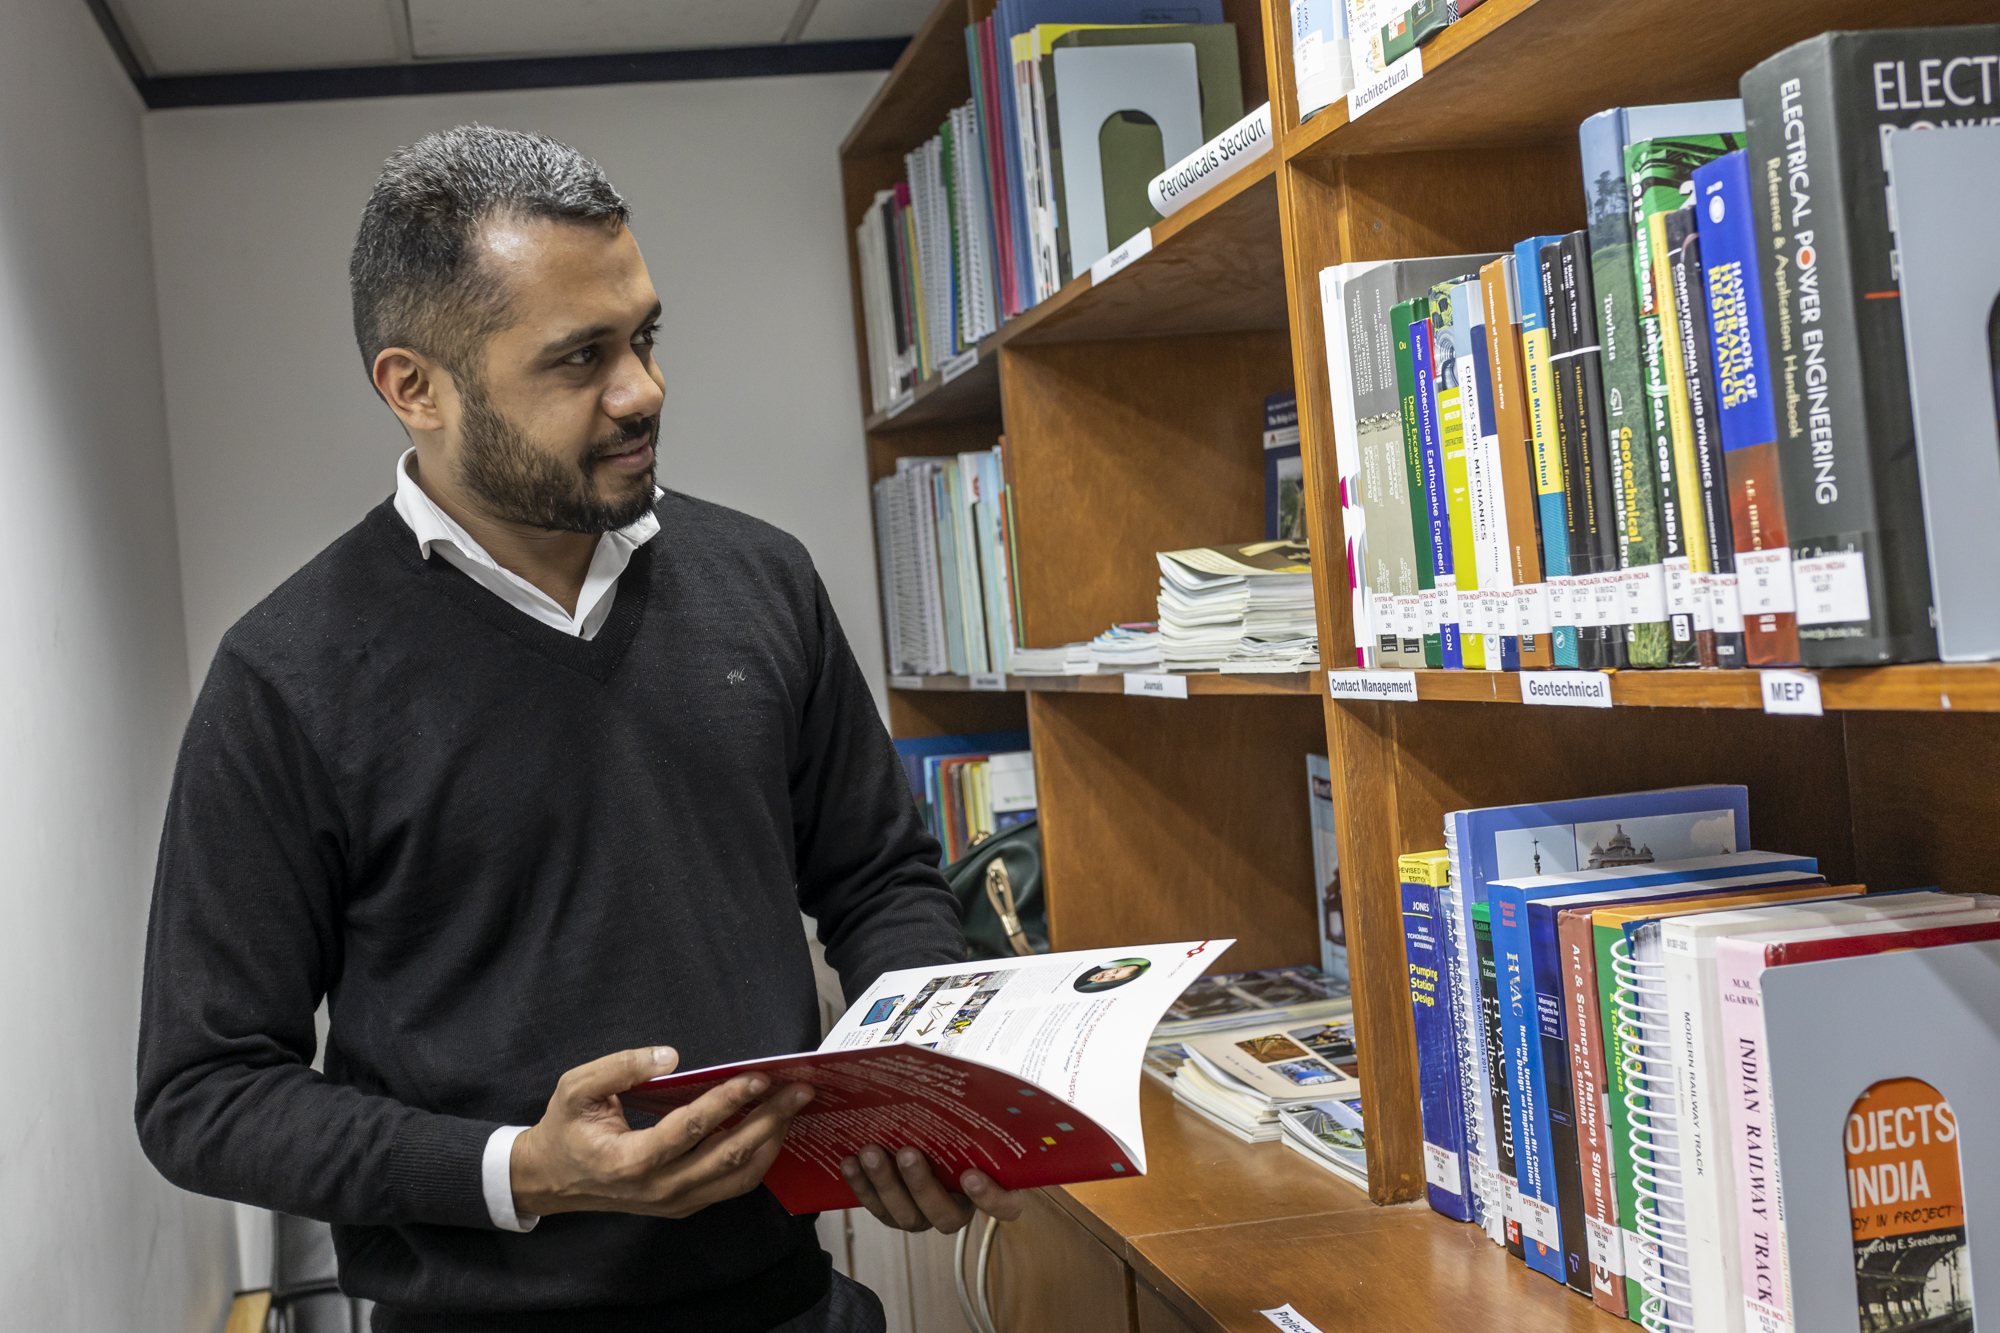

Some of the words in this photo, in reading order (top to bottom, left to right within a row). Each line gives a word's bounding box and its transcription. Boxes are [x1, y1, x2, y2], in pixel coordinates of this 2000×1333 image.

[1355, 63, 1409, 110] Architectural
[1873, 56, 2000, 110] ELECT
[1159, 147, 1219, 202] Periodicals
[1219, 118, 1266, 161] Section
[1780, 78, 1812, 227] ELECTRICAL
[1630, 171, 1644, 223] 2012
[1768, 156, 1783, 233] Reference
[1636, 227, 1653, 313] UNIFORM
[1795, 229, 1823, 324] POWER
[1488, 282, 1496, 325] Handbook
[1604, 293, 1616, 361] Towhata
[1676, 262, 1698, 375] COMPUTATIONAL
[1775, 254, 1793, 351] Applications
[1383, 324, 1393, 388] GEOTECHNICAL
[1415, 335, 1423, 361] Kramer
[1492, 327, 1498, 336] of
[1493, 337, 1501, 365] Tunnel
[1527, 340, 1535, 360] The
[1708, 265, 1736, 410] RESISTANCE
[1721, 263, 1748, 403] HYDRAULIC
[1731, 261, 1753, 370] HANDBOOK
[1744, 373, 1758, 399] OF
[1364, 331, 1374, 393] GEOTECHNICAL
[1530, 364, 1539, 393] Deep
[1645, 317, 1665, 430] MECHANICAL
[1408, 395, 1417, 425] Deep
[1465, 365, 1476, 420] CRAIG'S
[1554, 371, 1564, 418] Handbook
[1575, 366, 1585, 416] Handbook
[1691, 378, 1703, 415] FLUID
[1783, 354, 1803, 440] Handbook
[1803, 328, 1838, 505] ENGINEERING
[1418, 370, 1433, 446] Geotechnical
[1426, 449, 1440, 517] Earthquake
[1471, 424, 1479, 455] SOIL
[1533, 398, 1543, 438] Mixing
[1580, 418, 1587, 429] of
[1364, 446, 1373, 498] engineering
[1385, 442, 1395, 495] engineering
[1389, 441, 1400, 499] geotechnical
[1411, 428, 1422, 486] Excavation
[1538, 442, 1549, 486] Method
[1561, 434, 1569, 467] Tunnel
[1581, 431, 1590, 464] Tunnel
[1657, 435, 1671, 482] CODE
[1695, 418, 1712, 488] DYNAMICS
[1368, 446, 1379, 502] geotechnical
[1474, 459, 1487, 541] MECHANICS
[1563, 468, 1573, 526] Engineering
[1585, 466, 1595, 525] Engineering
[1610, 429, 1627, 531] Earthquake
[1620, 427, 1642, 542] Geotechnical
[1664, 502, 1678, 554] INDIA
[1331, 678, 1360, 692] Contact
[1361, 679, 1412, 696] Management
[1529, 680, 1604, 698] Geotechnical
[1771, 682, 1804, 701] MEP
[1412, 902, 1430, 912] JONES
[1445, 910, 1453, 942] RIFFAT
[1409, 963, 1438, 982] Pumping
[1571, 943, 1582, 970] Art
[1574, 975, 1583, 988] &
[1411, 977, 1435, 992] Station
[1412, 991, 1435, 1007] Design
[1448, 956, 1460, 1028] TREATMENT
[1474, 978, 1482, 1001] INDIAN
[1506, 951, 1523, 1017] HVAC
[1732, 978, 1754, 990] M.M.
[1456, 1034, 1464, 1052] AND
[1476, 1002, 1484, 1036] WEATHER
[1575, 993, 1589, 1055] Science
[1684, 1011, 1695, 1068] MODERN
[1482, 997, 1499, 1098] Handbook
[1573, 1043, 1582, 1067] R.C.
[1582, 1060, 1593, 1077] of
[1611, 1008, 1624, 1092] Techniques
[1067, 1070, 1079, 1104] happy
[1459, 1056, 1473, 1144] ENGINEERING
[1519, 1024, 1529, 1065] Heating,
[1524, 1067, 1535, 1121] Ventilation
[1530, 1138, 1538, 1153] Air
[1575, 1070, 1588, 1125] SHARMA
[1689, 1071, 1700, 1129] RAILWAY
[1739, 1037, 1760, 1112] INDIAN
[1516, 1059, 1526, 1092] Design
[1521, 1109, 1535, 1185] Implementation
[1585, 1080, 1599, 1146] Railway
[1694, 1132, 1704, 1177] TRACK
[1746, 1123, 1768, 1220] RAILWAY
[1522, 1197, 1539, 1209] SYSTRA
[1540, 1205, 1550, 1214] INDIA
[1849, 1158, 1932, 1209] INDIA
[1876, 1213, 1888, 1227] IN
[1894, 1204, 1956, 1226] PROJECT
[1753, 1230, 1774, 1306] TRACK
[1885, 1240, 1897, 1253] by
[1897, 1237, 1907, 1250] E.
[1907, 1233, 1957, 1249] Sreedharan
[1745, 1299, 1771, 1316] SYSTRA
